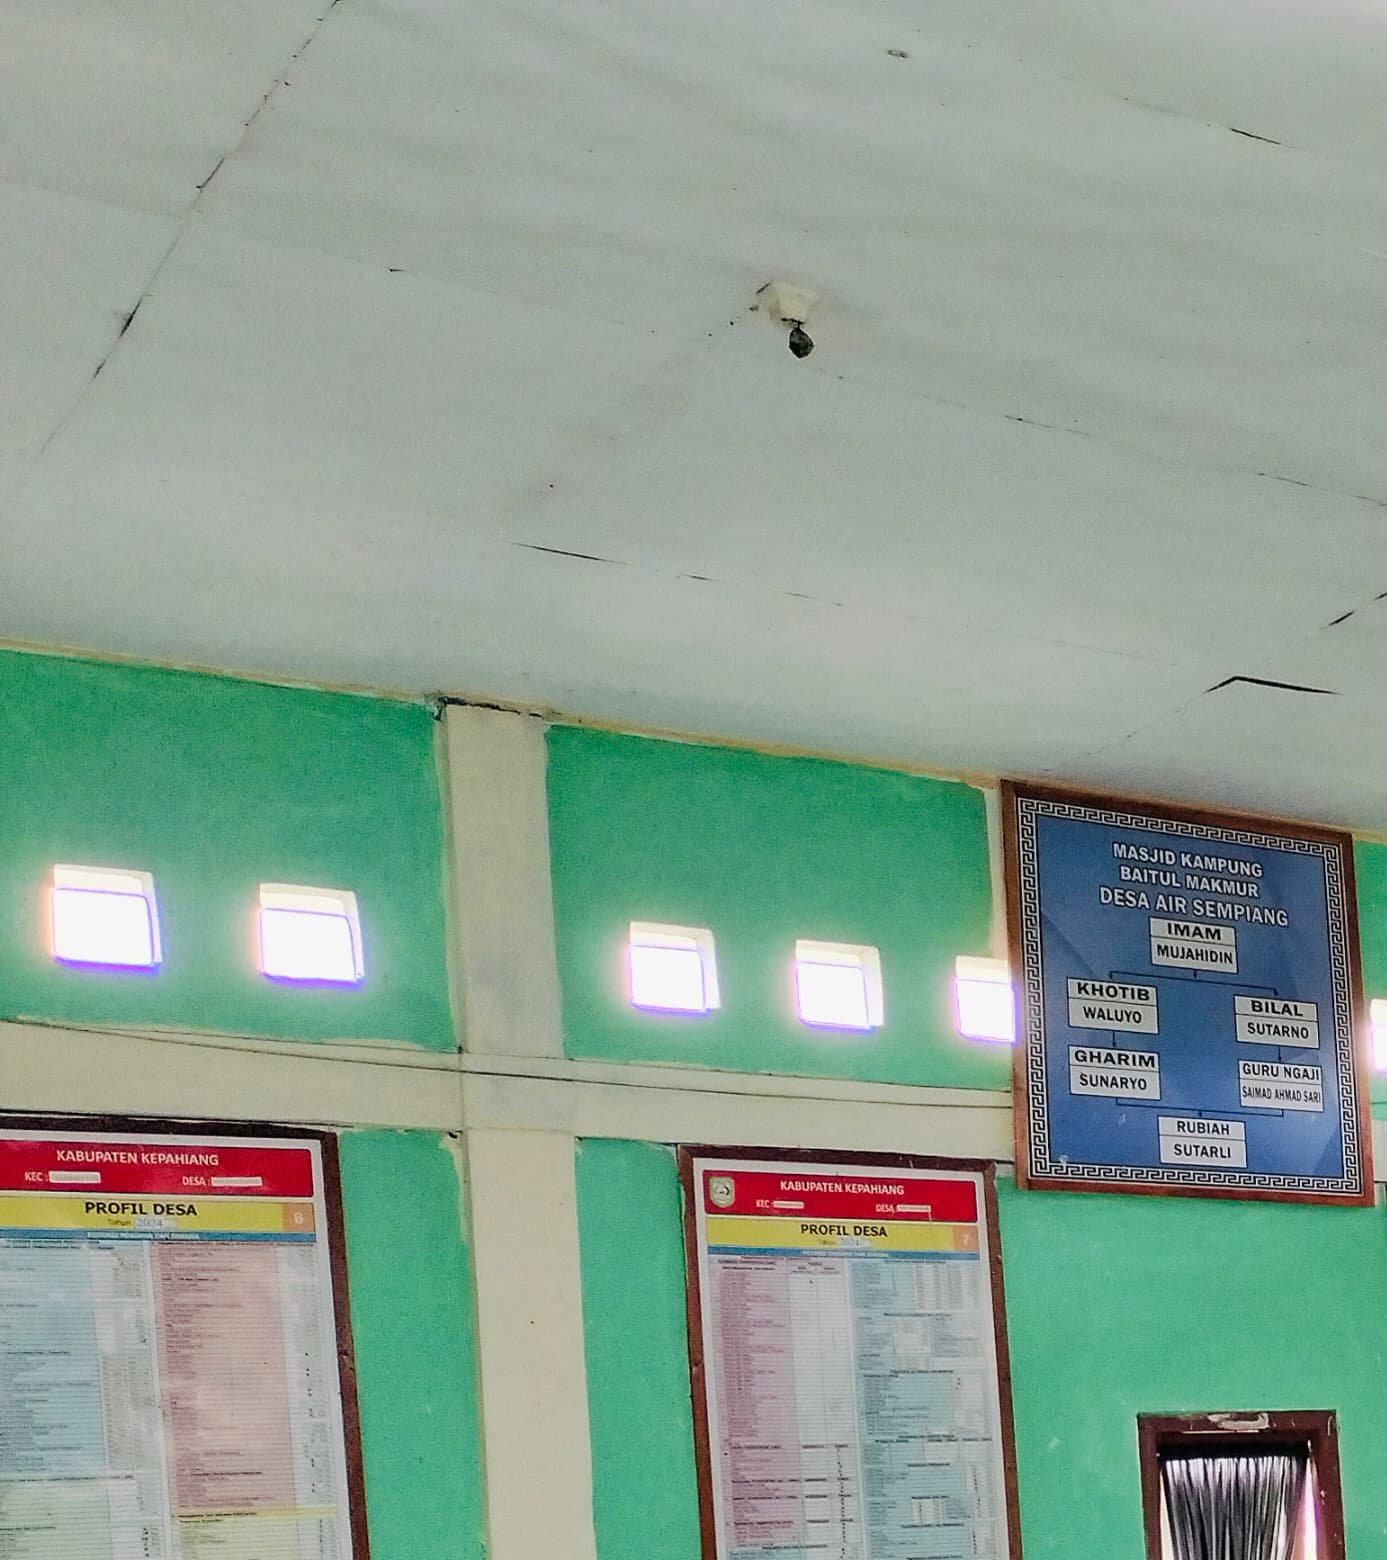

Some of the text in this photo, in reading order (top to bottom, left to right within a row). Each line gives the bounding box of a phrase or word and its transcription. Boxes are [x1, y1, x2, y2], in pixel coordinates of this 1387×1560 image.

[1113, 842, 1262, 877] MASJID KAMPUNG
[1120, 866, 1259, 897] BAITUL MAKMUR
[1100, 887, 1288, 927] DESA AIR SEMPIANG
[1168, 923, 1221, 941] IMAM
[1157, 945, 1233, 964] MUJAHIDIN
[1077, 982, 1150, 1000] KHOTIB
[1083, 1006, 1142, 1024] WALUYO
[1251, 1000, 1303, 1017] BILAL
[1247, 1022, 1309, 1039] SUTARNO
[1075, 1050, 1156, 1069] GHARIM
[1242, 1063, 1319, 1081] GURU NGAJI
[1080, 1072, 1147, 1091] SUNARYO
[1274, 1087, 1301, 1101] AHMAD
[1303, 1090, 1321, 1103] SARI
[1177, 1120, 1229, 1135] RUBIAH
[56, 1150, 219, 1165] KABUPATEN KEPAHIANG
[1174, 1143, 1231, 1158] SUTARLI
[25, 1172, 43, 1181] KEC
[182, 1176, 207, 1186] DESA
[780, 1181, 904, 1195] KABUPATEN KEPAHIANG
[85, 1202, 197, 1216] PROFIL DESA
[801, 1224, 887, 1237] PROFIL DESA
